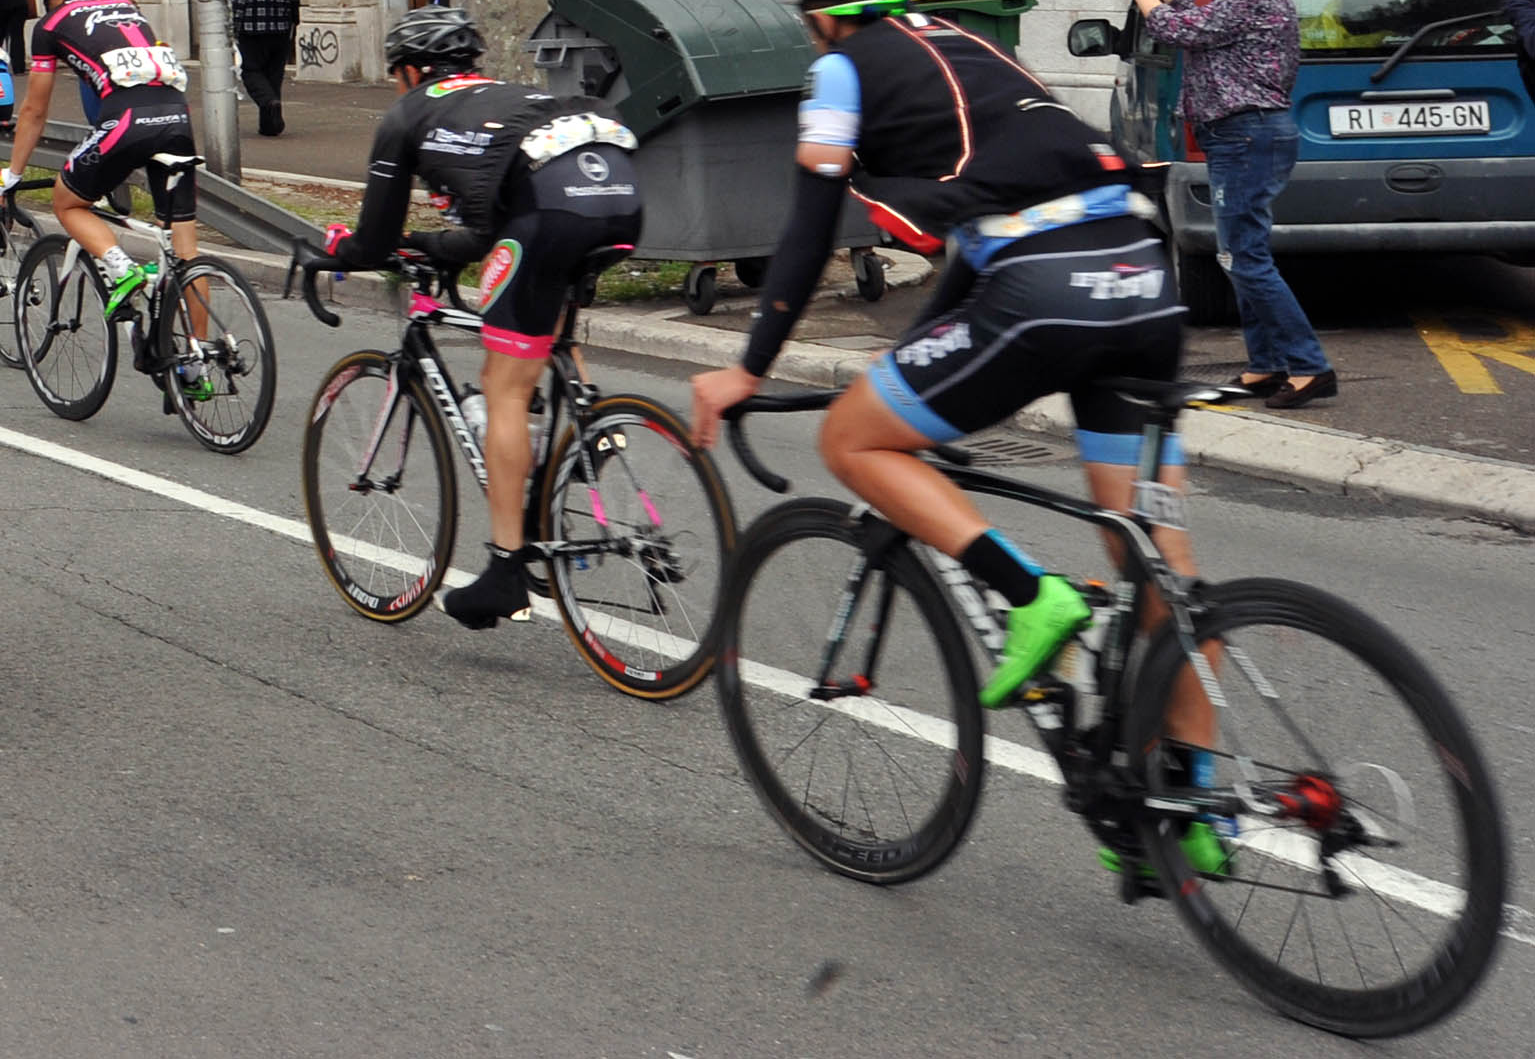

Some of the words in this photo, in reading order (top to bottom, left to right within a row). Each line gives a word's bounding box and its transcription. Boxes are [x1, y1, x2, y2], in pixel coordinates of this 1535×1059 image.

[116, 50, 143, 70] 48
[135, 114, 181, 125] KUOTA
[1348, 108, 1374, 130] RI
[1398, 105, 1484, 129] 445-GN
